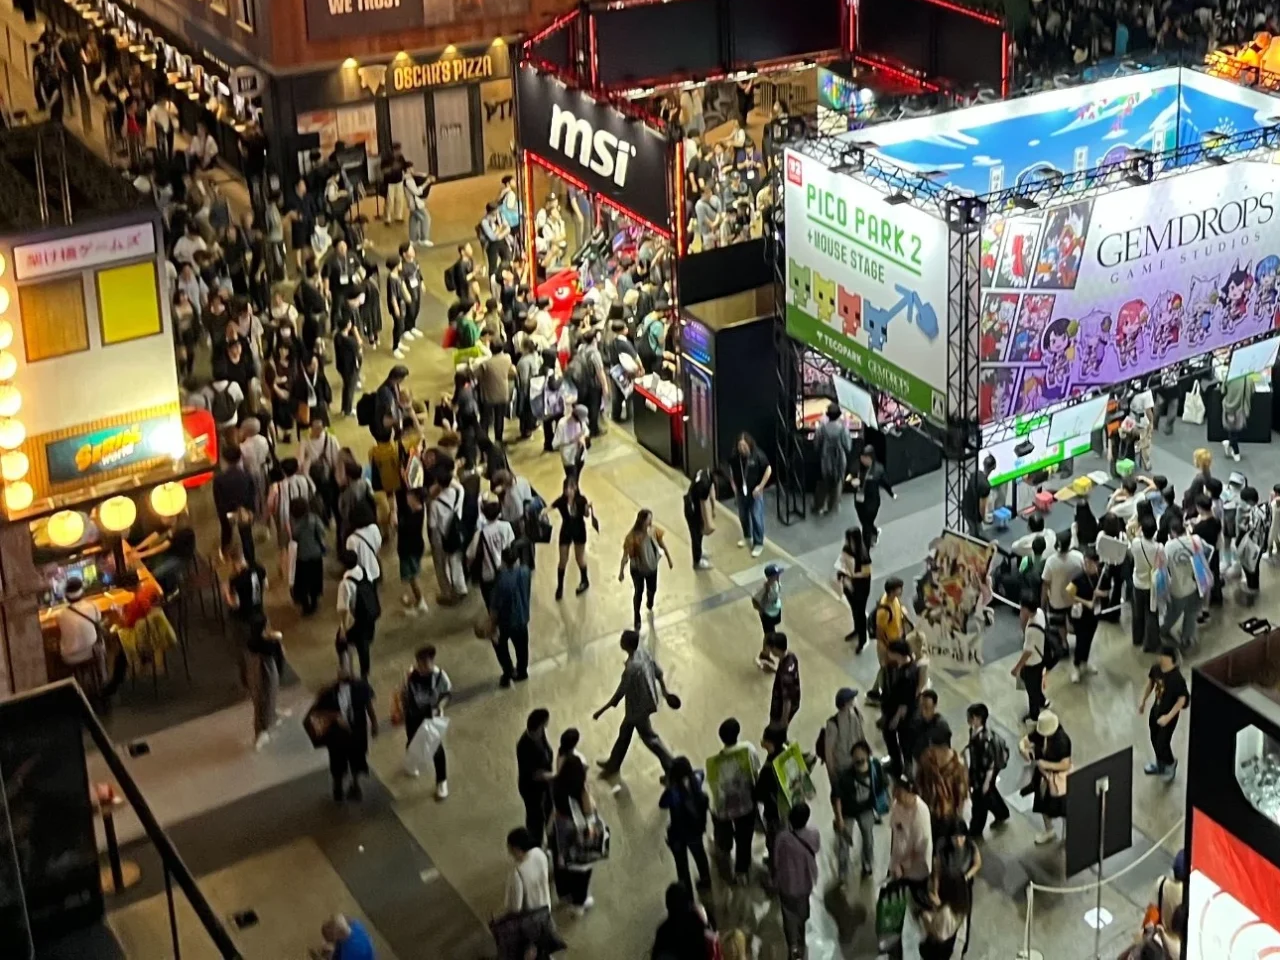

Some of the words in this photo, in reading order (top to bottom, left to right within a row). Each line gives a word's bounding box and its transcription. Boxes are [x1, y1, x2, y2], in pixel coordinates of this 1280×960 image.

[394, 60, 451, 90] OSCAR'S
[453, 54, 493, 81] PIZZA
[549, 103, 630, 188] msi
[806, 183, 847, 227] PICO
[855, 206, 905, 258] PARK
[910, 234, 922, 266] 2
[1096, 191, 1275, 269] GEMDROPS
[850, 250, 885, 284] STAGE
[1110, 259, 1167, 285] GAME
[1180, 231, 1262, 264] STUDIOS
